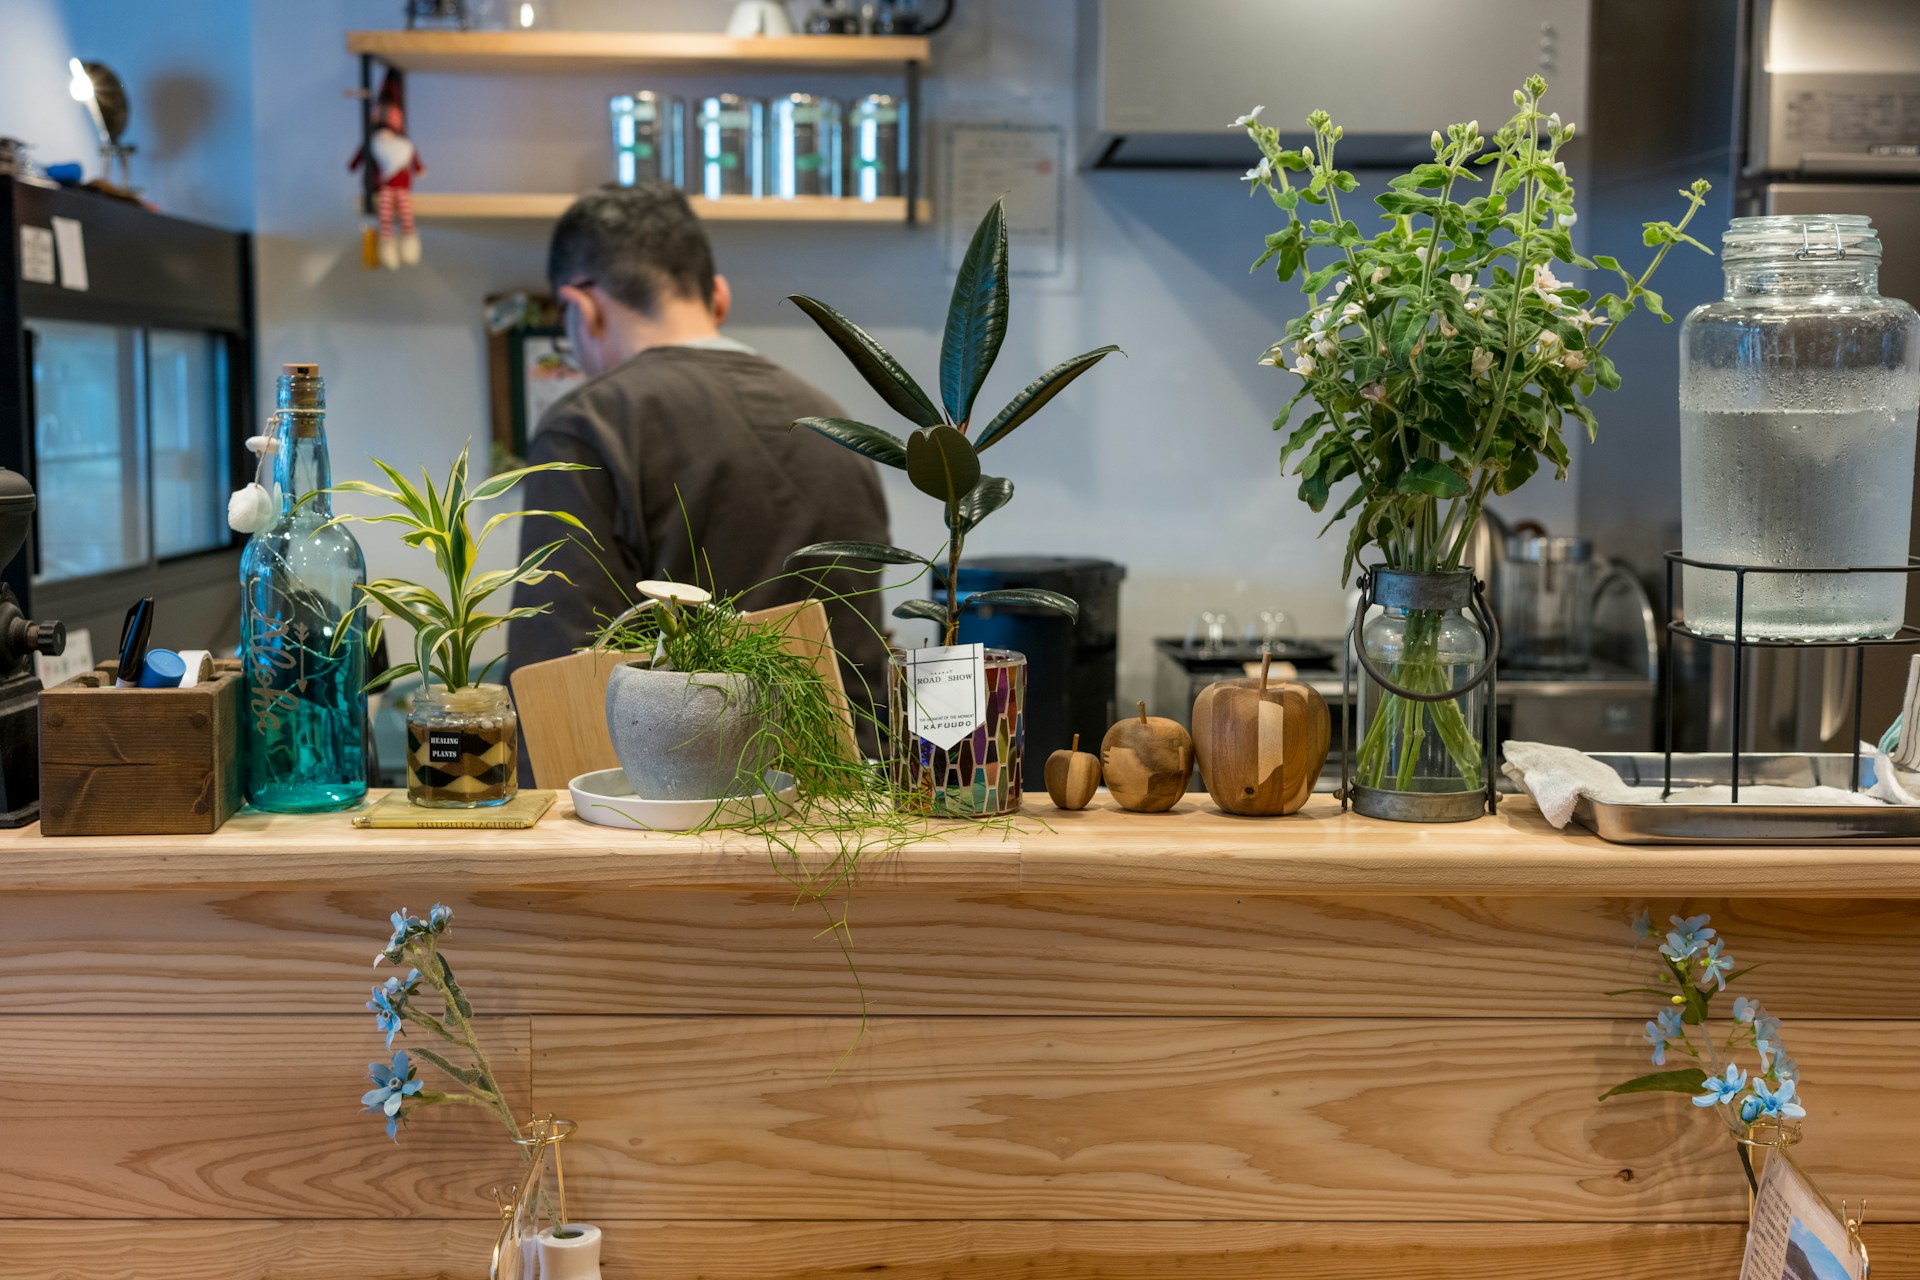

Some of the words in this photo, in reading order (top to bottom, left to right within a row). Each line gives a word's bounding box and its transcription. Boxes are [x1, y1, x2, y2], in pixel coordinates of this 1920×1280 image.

[250, 607, 299, 736] Aloha
[430, 737, 459, 745] HEALING
[432, 750, 457, 758] PLANTS
